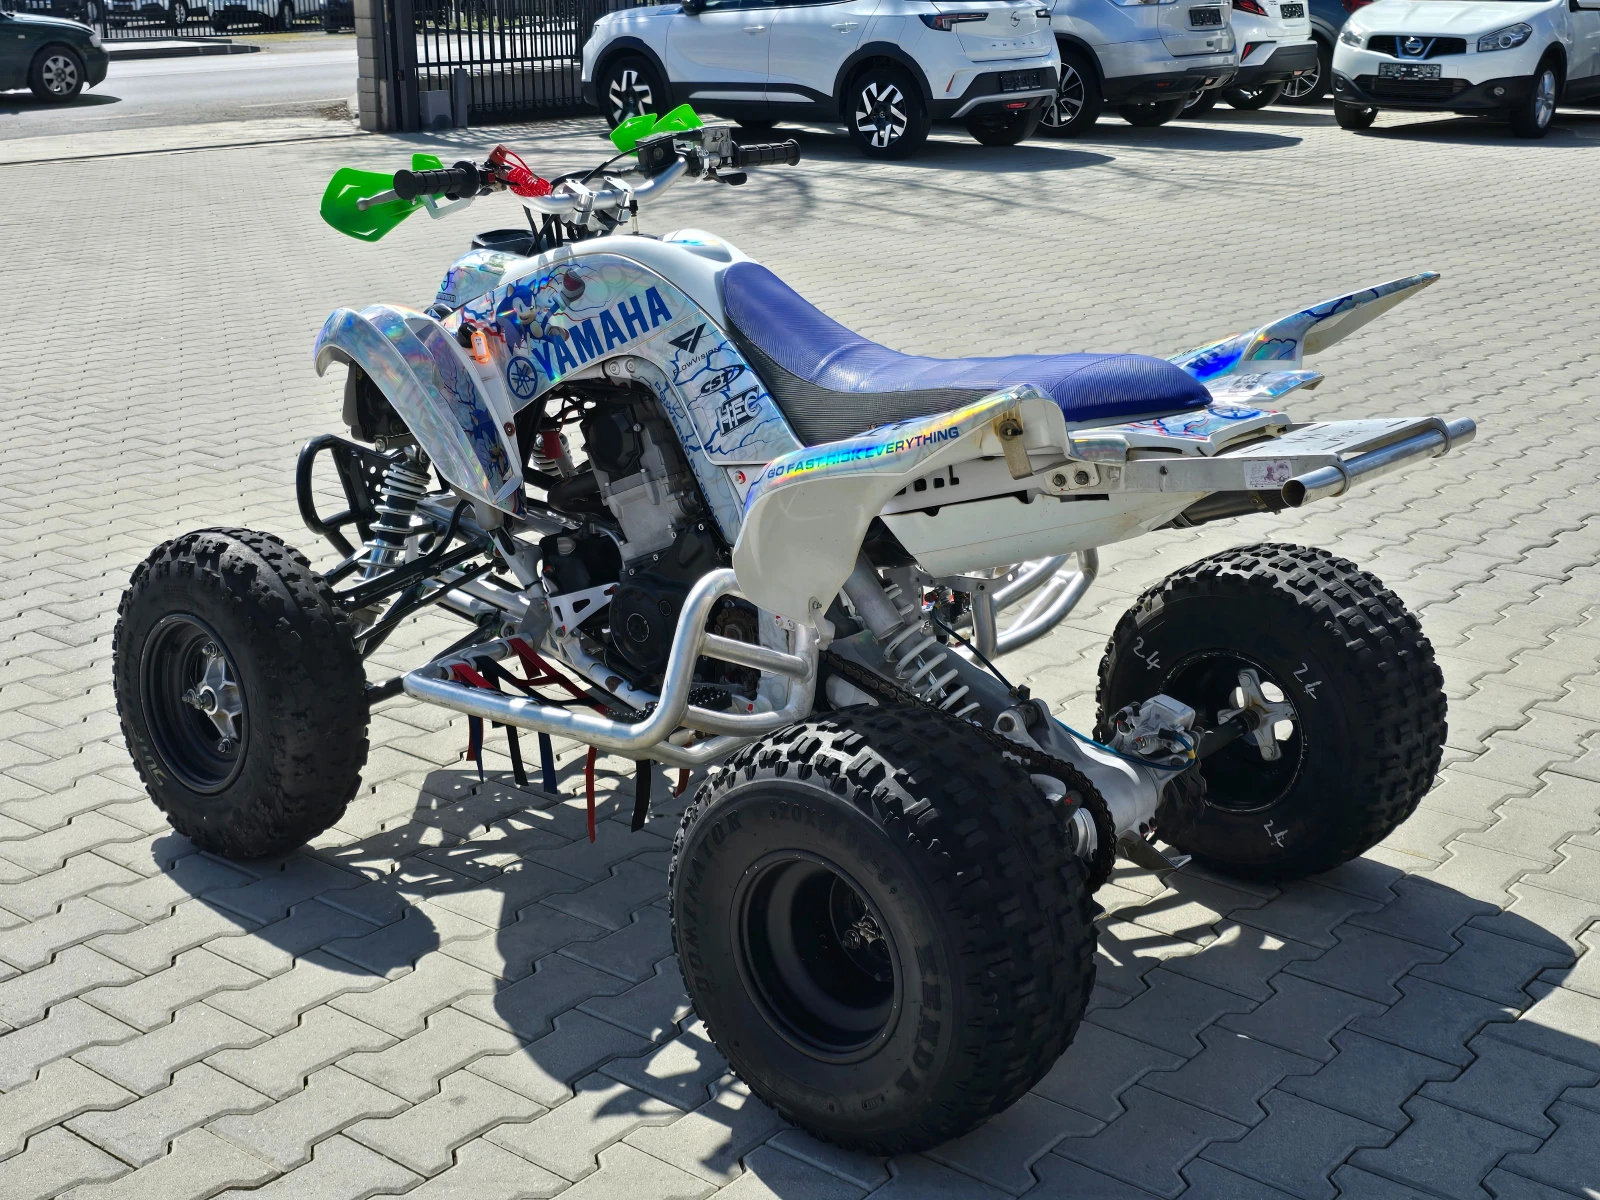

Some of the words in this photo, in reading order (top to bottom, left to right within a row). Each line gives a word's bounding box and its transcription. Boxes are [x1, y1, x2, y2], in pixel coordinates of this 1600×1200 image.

[531, 286, 673, 382] YAMAHA
[700, 367, 734, 394] CST
[654, 381, 691, 457] POWERED
[715, 390, 763, 437] HFC
[767, 465, 784, 479] GO
[785, 456, 826, 474] FAST
[826, 448, 862, 467] RISK
[864, 426, 960, 458] EVERYTHING
[1132, 637, 1161, 670] 24
[1292, 662, 1323, 700] 24
[1263, 819, 1289, 848] 24
[682, 808, 744, 995] DOMINATOR
[895, 944, 942, 1093] KENDA
